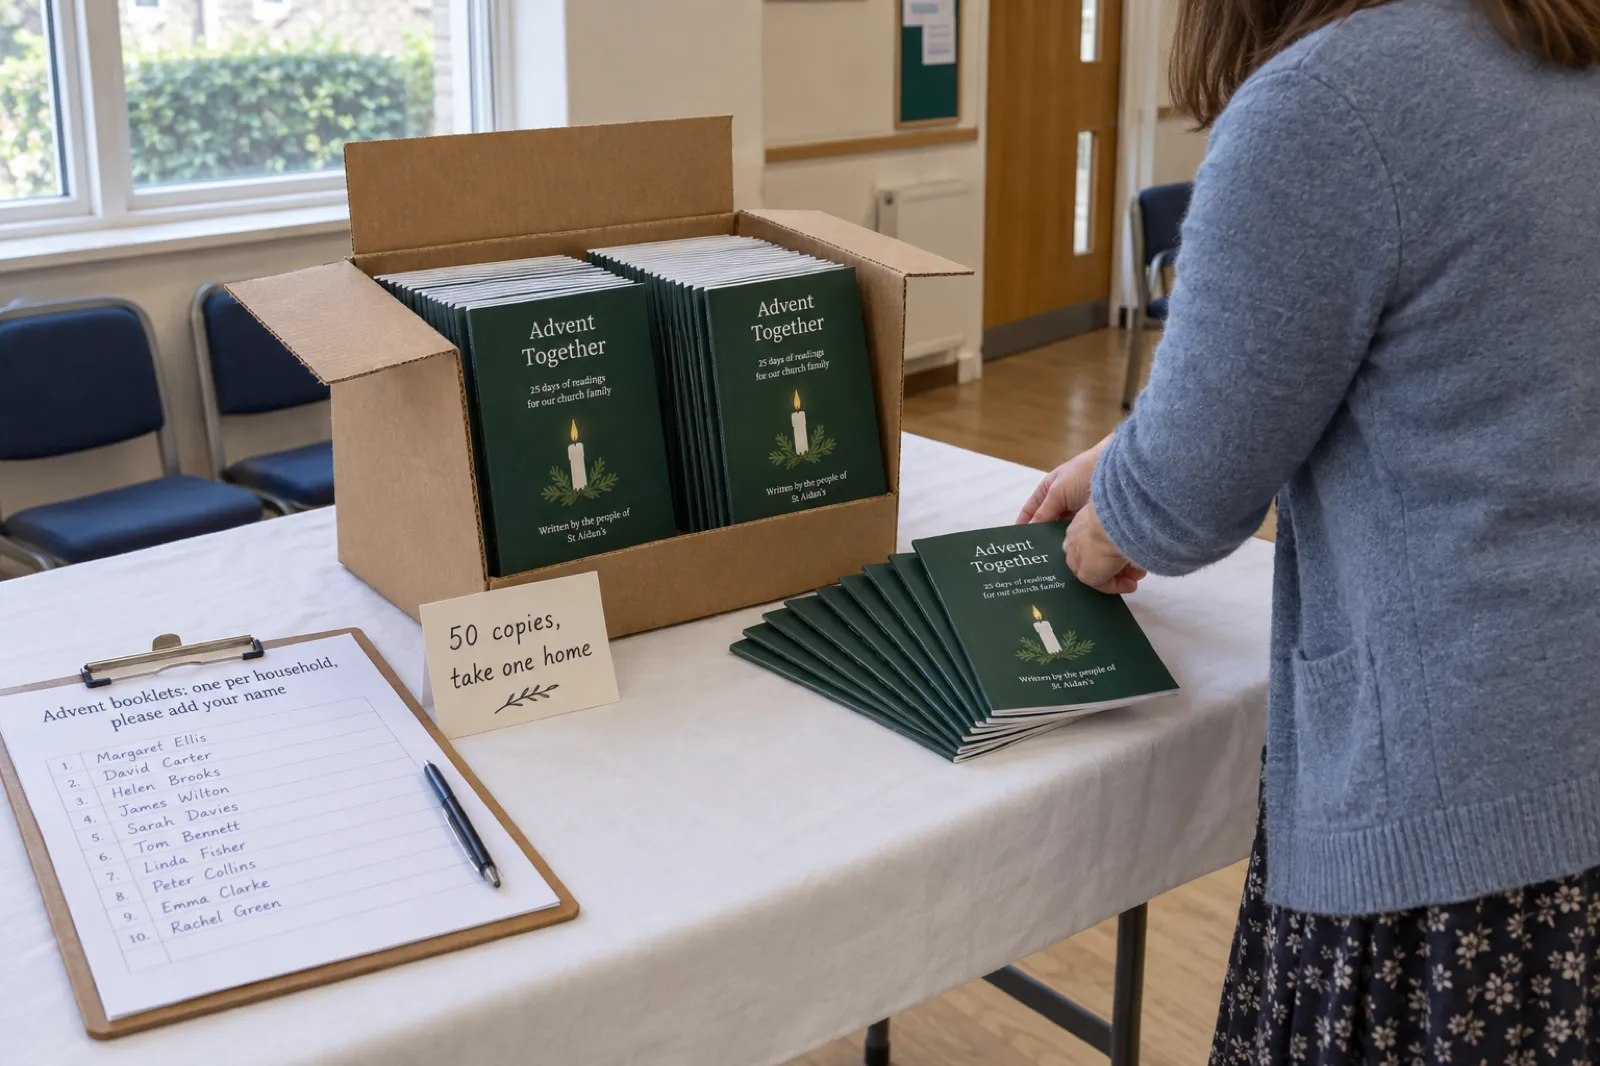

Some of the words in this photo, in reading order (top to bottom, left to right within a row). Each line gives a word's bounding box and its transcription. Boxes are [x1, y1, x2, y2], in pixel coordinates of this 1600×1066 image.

[757, 294, 815, 317] Advent
[529, 315, 596, 340] Advent
[751, 317, 824, 343] Together
[521, 339, 606, 368] Together
[758, 359, 767, 367] 25
[768, 357, 784, 366] days
[785, 353, 794, 362] of
[530, 386, 540, 394] 25
[542, 383, 560, 393] days
[562, 379, 571, 388] of
[572, 375, 606, 386] readings
[756, 372, 767, 381] for
[768, 370, 780, 378] our
[782, 364, 806, 375] church
[807, 359, 830, 370] family
[527, 400, 540, 408] for
[557, 390, 584, 403] church
[586, 386, 612, 398] family
[766, 485, 793, 496] Written
[794, 482, 803, 492] by
[804, 480, 815, 488] the
[816, 473, 838, 487] people
[840, 470, 847, 479] of
[791, 495, 799, 503] St
[538, 525, 569, 535] Written
[570, 520, 580, 530] by
[581, 517, 595, 526] the
[596, 511, 621, 526] people
[622, 507, 630, 517] of
[567, 534, 576, 543] St
[975, 539, 1035, 557] Advent
[970, 554, 1048, 573] Together
[450, 624, 478, 650] 50
[492, 614, 560, 645] copies,
[450, 662, 494, 689] take
[502, 657, 534, 676] one
[543, 643, 592, 666] home
[1051, 673, 1062, 681] by
[1063, 671, 1077, 679] the
[1078, 666, 1105, 678] people
[1106, 663, 1116, 671] of
[42, 702, 106, 723] Advent
[109, 683, 188, 709] booklets:
[192, 681, 221, 693] one
[225, 674, 250, 691] per
[256, 657, 338, 682] household,
[111, 709, 163, 731] please
[169, 701, 199, 717] add
[202, 694, 239, 713] your
[244, 685, 287, 701] name
[62, 762, 73, 770] 1.
[97, 741, 164, 764] Margaret
[174, 734, 206, 748] Ellis
[68, 780, 80, 788] 2.
[103, 762, 150, 781] David
[162, 752, 212, 768] Carter
[76, 797, 88, 806] 3.
[111, 783, 156, 799] Helen
[169, 768, 221, 786] Brooks
[83, 815, 96, 824] 4.
[119, 800, 167, 817] James
[178, 786, 230, 803] Wilton
[92, 833, 104, 842] 5.
[127, 816, 175, 835] Sarah
[186, 803, 239, 821] Davies
[99, 853, 112, 861] 6.
[133, 840, 170, 854] Tom
[182, 822, 241, 843] Bennett
[106, 872, 120, 881] 7.
[144, 856, 189, 874] Linda
[200, 841, 246, 859] Fisher
[116, 892, 128, 901] 8.
[152, 876, 194, 892] Peter
[204, 860, 256, 880] Collins
[123, 912, 137, 922] 9.
[162, 895, 210, 913] Emma
[219, 879, 271, 899] Clarke
[129, 933, 150, 943] 10.
[171, 910, 223, 934] Rachel
[233, 900, 282, 917] Green
